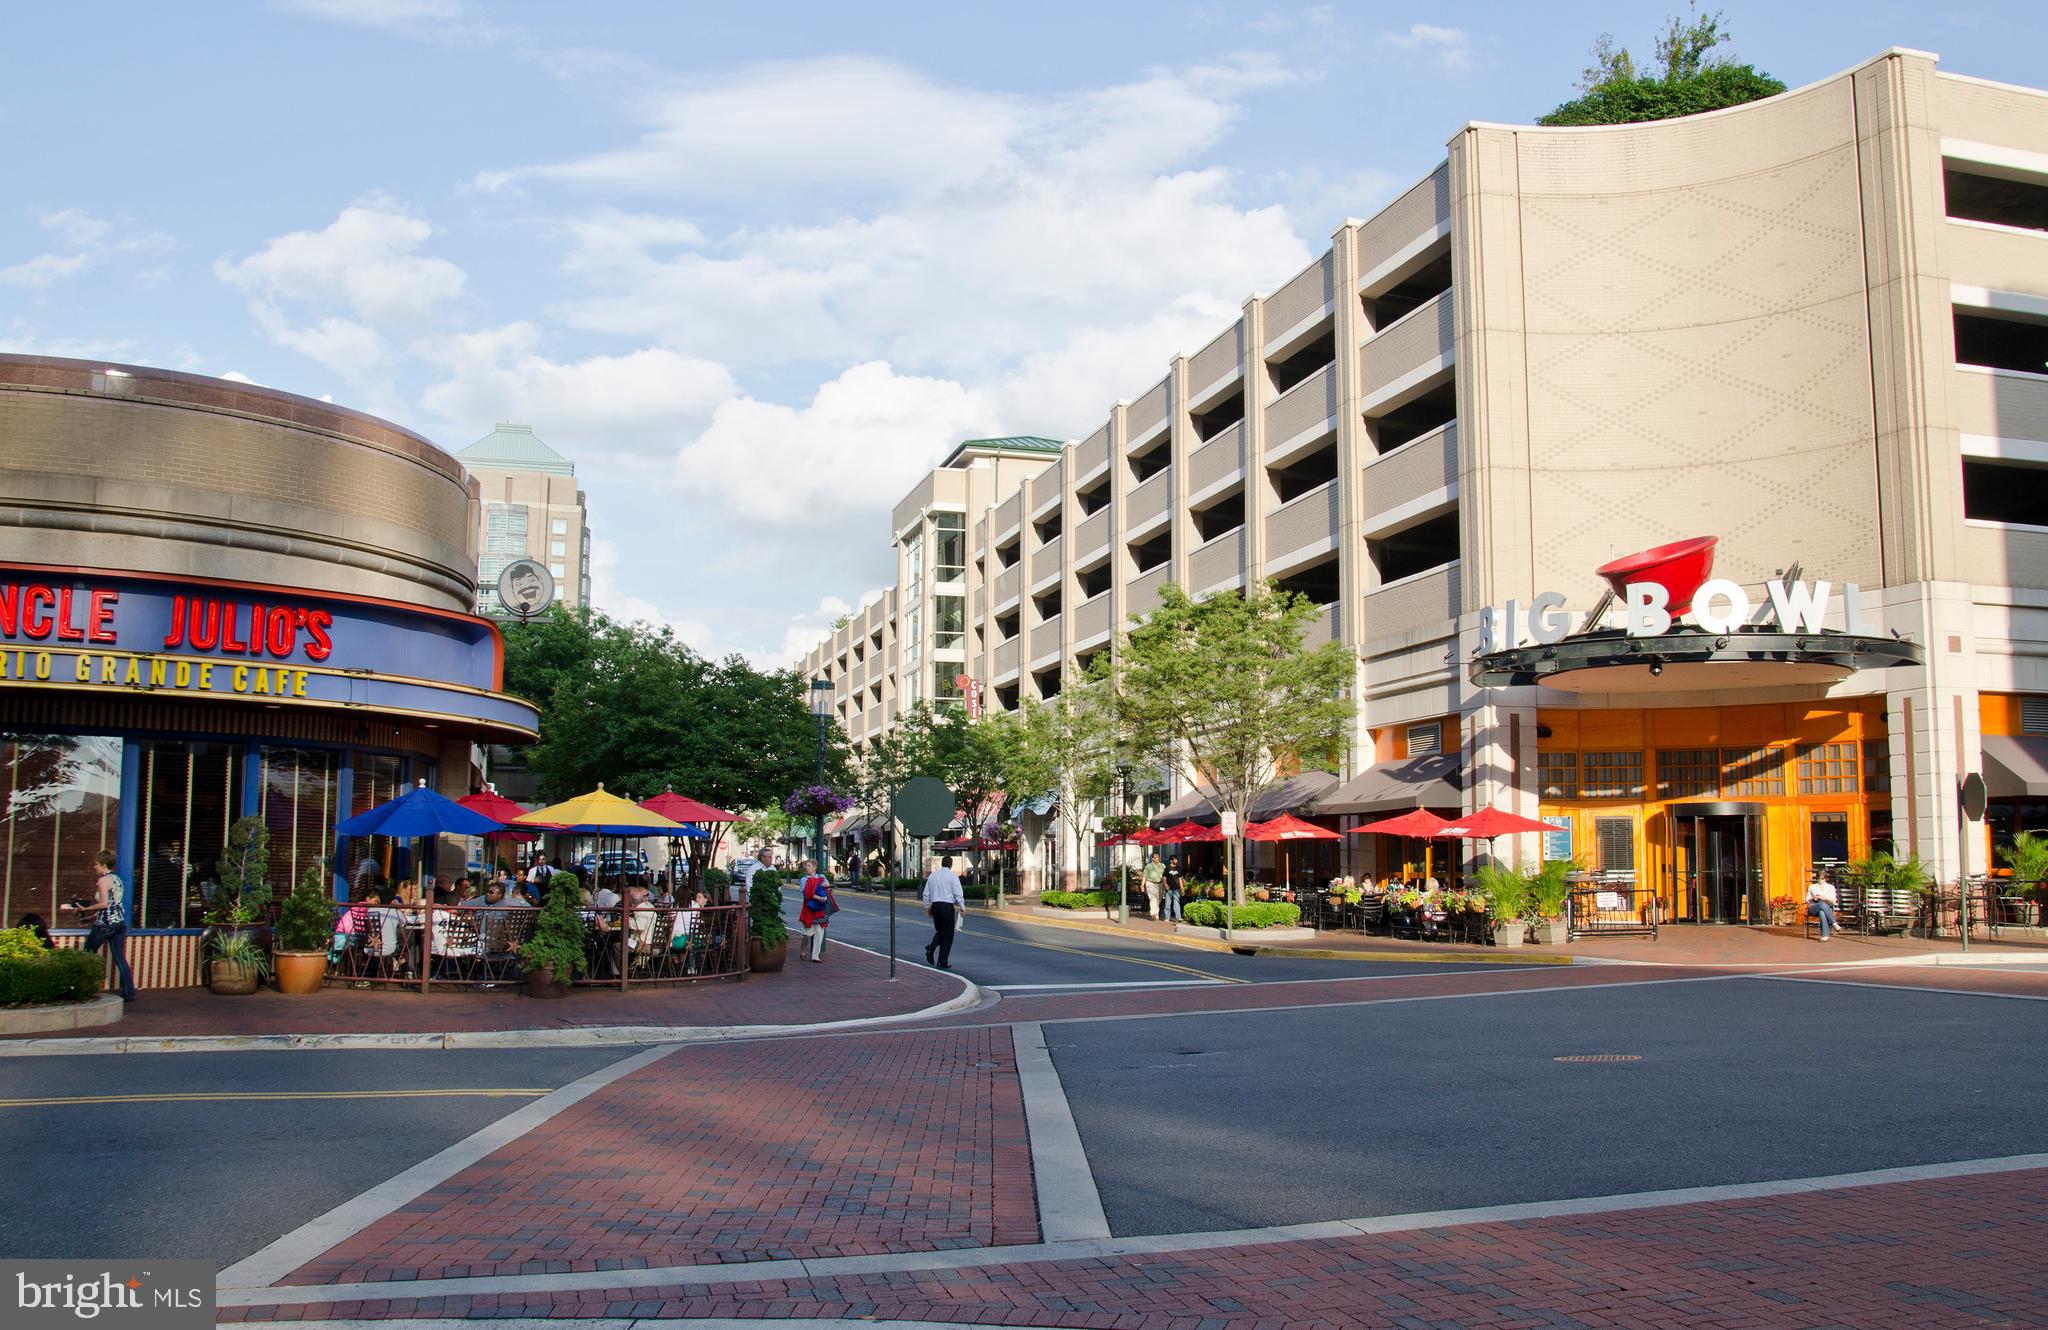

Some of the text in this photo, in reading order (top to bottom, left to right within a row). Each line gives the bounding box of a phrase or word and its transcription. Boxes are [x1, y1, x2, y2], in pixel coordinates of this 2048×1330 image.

[164, 595, 333, 662] JULIO'S
[1476, 578, 1876, 656] BIG BOWL
[75, 653, 214, 690] GRANDE
[232, 665, 309, 697] CAFE
